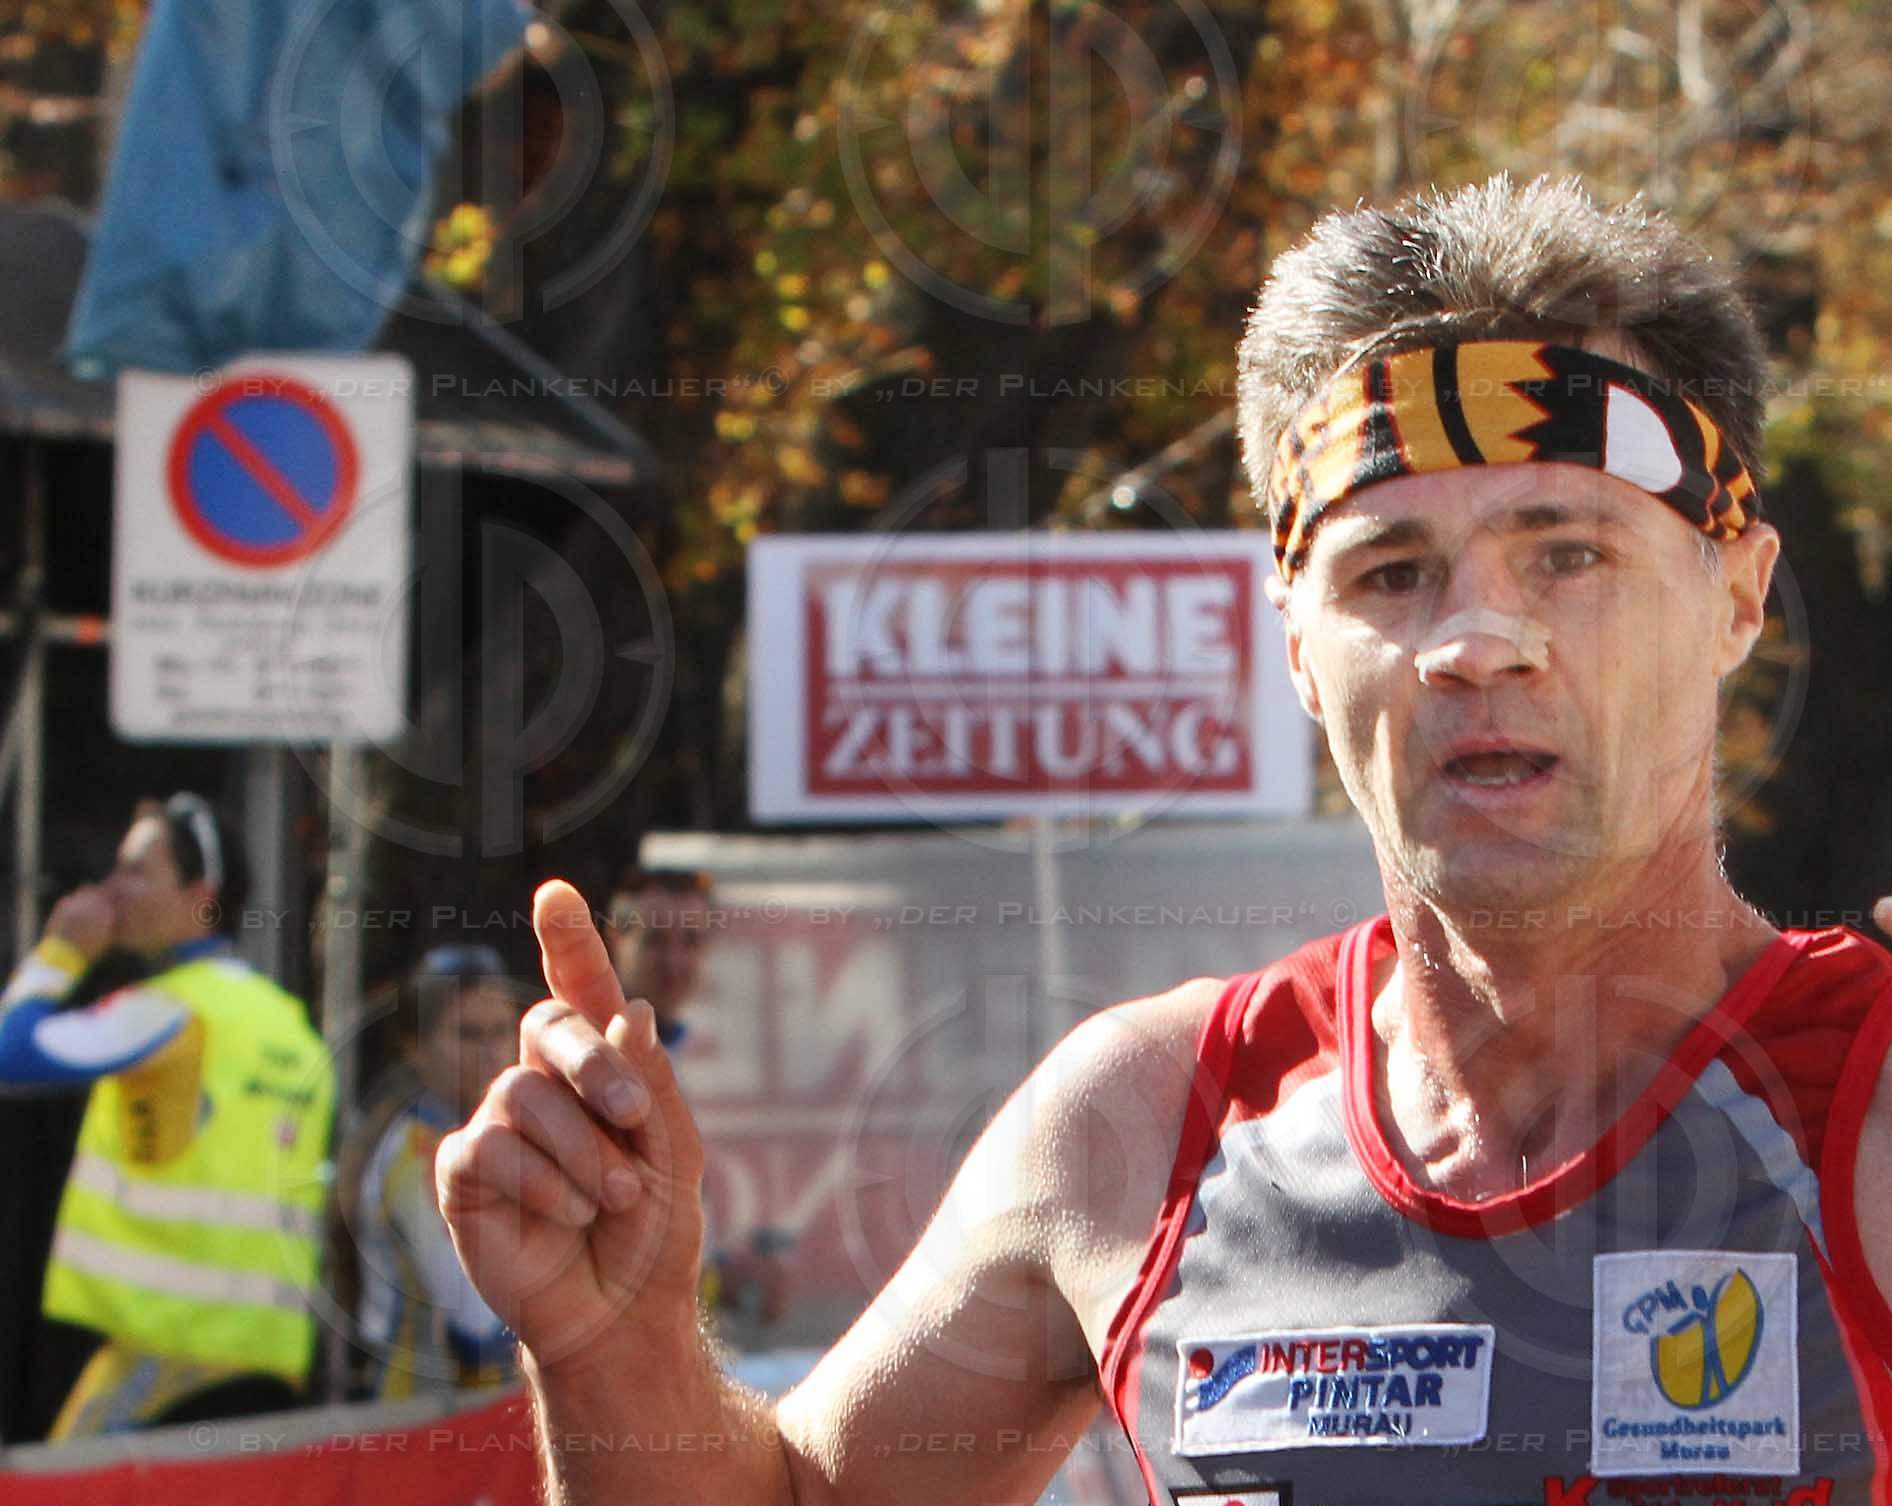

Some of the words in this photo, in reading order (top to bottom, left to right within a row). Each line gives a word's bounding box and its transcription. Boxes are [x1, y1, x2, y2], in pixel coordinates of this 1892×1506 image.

[823, 575, 1235, 675] KLEINE
[823, 701, 1242, 780] ZEITUNG
[1259, 1336, 1484, 1373] INTERSPORT
[1288, 1373, 1443, 1411] PINTAR
[1307, 1412, 1413, 1438] MURAU
[1602, 1416, 1786, 1439] Gesundheitspark
[1659, 1440, 1731, 1459] Murau
